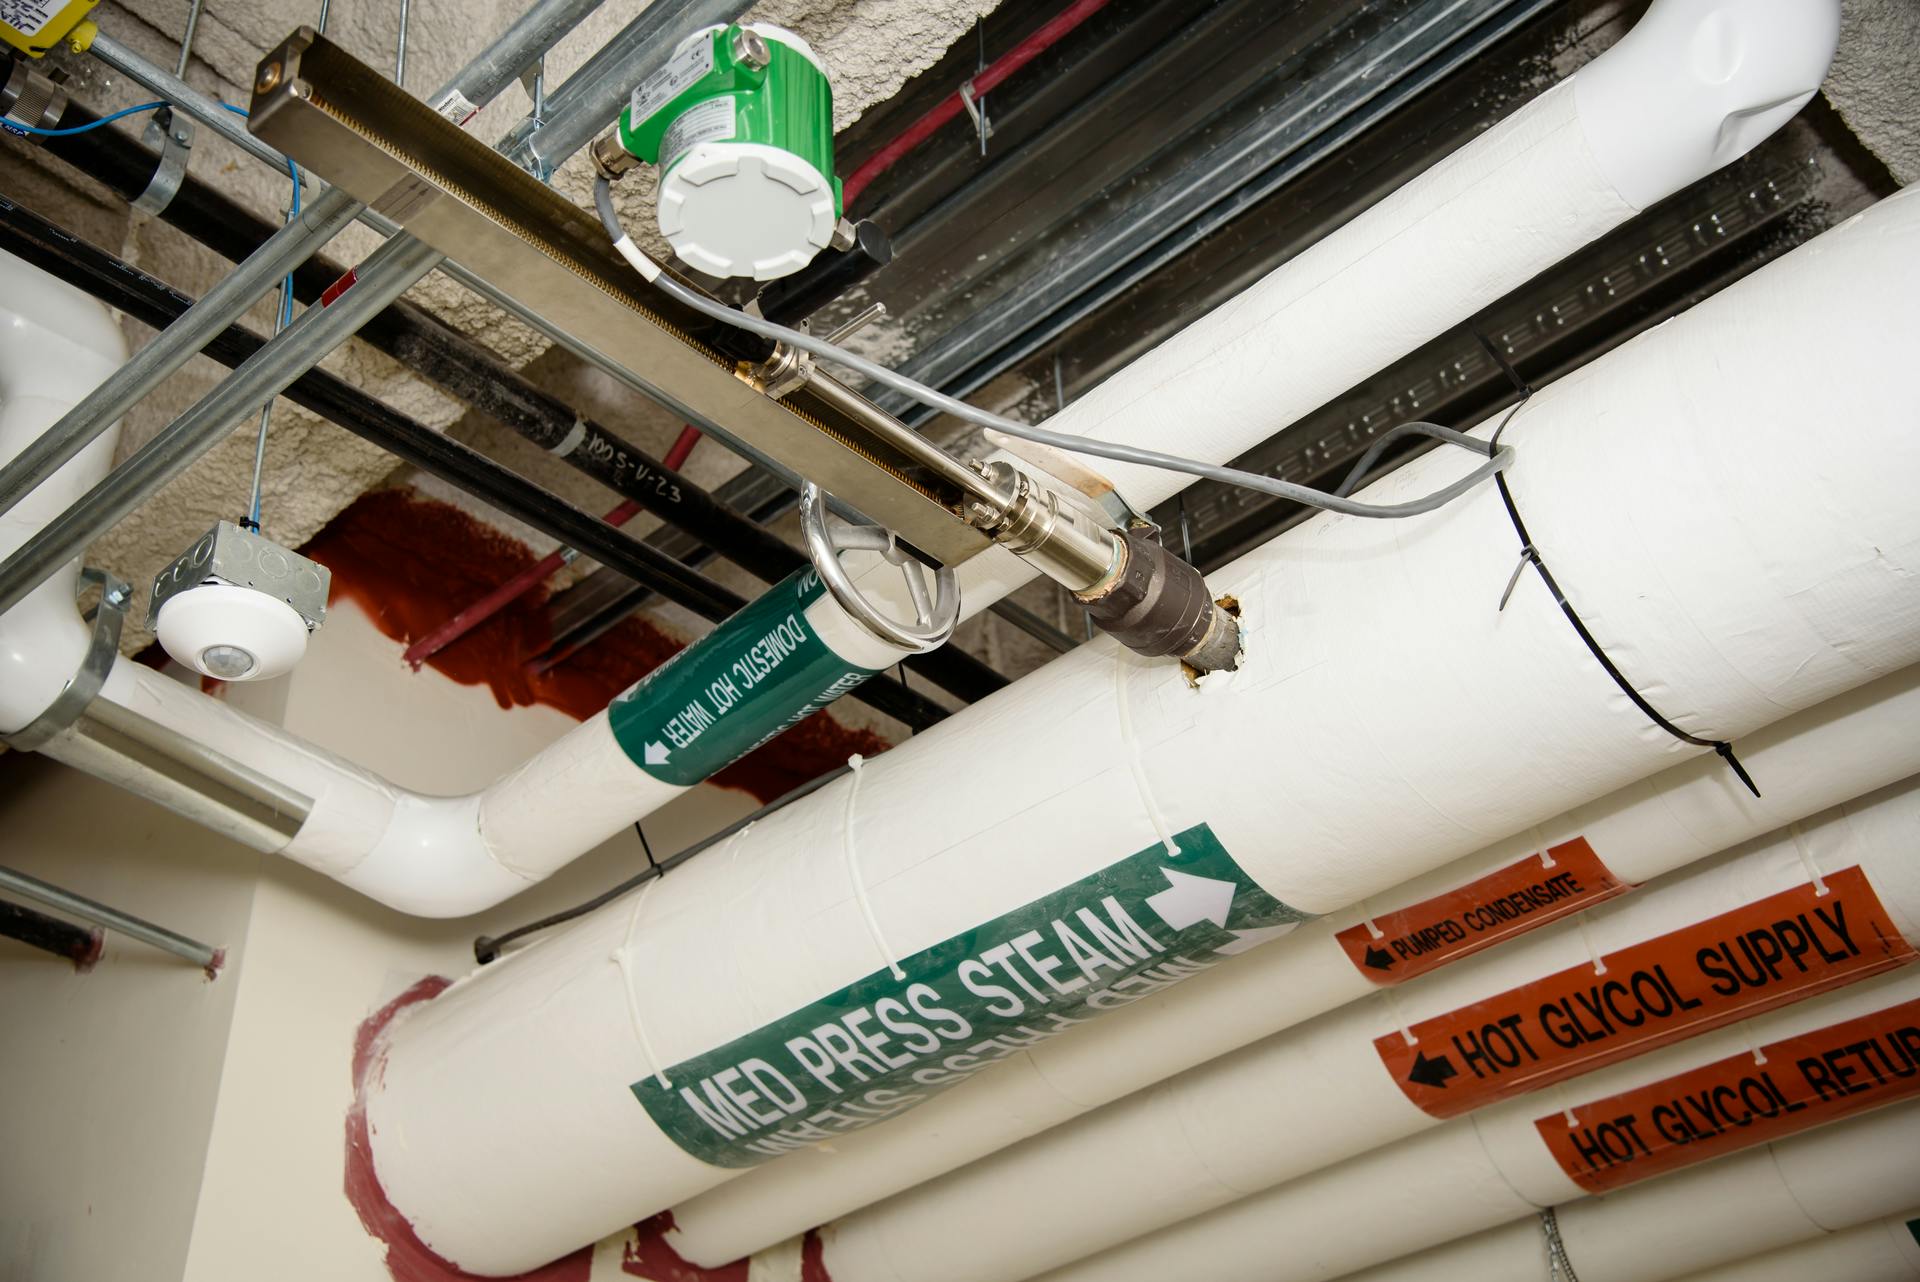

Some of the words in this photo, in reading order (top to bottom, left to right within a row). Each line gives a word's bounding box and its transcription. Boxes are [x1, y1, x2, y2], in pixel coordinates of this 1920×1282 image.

[704, 673, 743, 716] HOT
[732, 614, 808, 689] DOMESTIC
[661, 700, 717, 749] WATER
[1390, 919, 1466, 961] PUMPED
[1463, 871, 1585, 932] CONDENSATE
[679, 1057, 808, 1142] MED
[785, 983, 973, 1093] PRESS
[957, 895, 1165, 1018] STEAM
[1452, 1014, 1540, 1079] HOT
[1539, 964, 1703, 1050] GLYCOL
[1696, 901, 1861, 997] SUPPLY
[1569, 1114, 1653, 1177] HOT
[1651, 1072, 1808, 1146] GLYCOL
